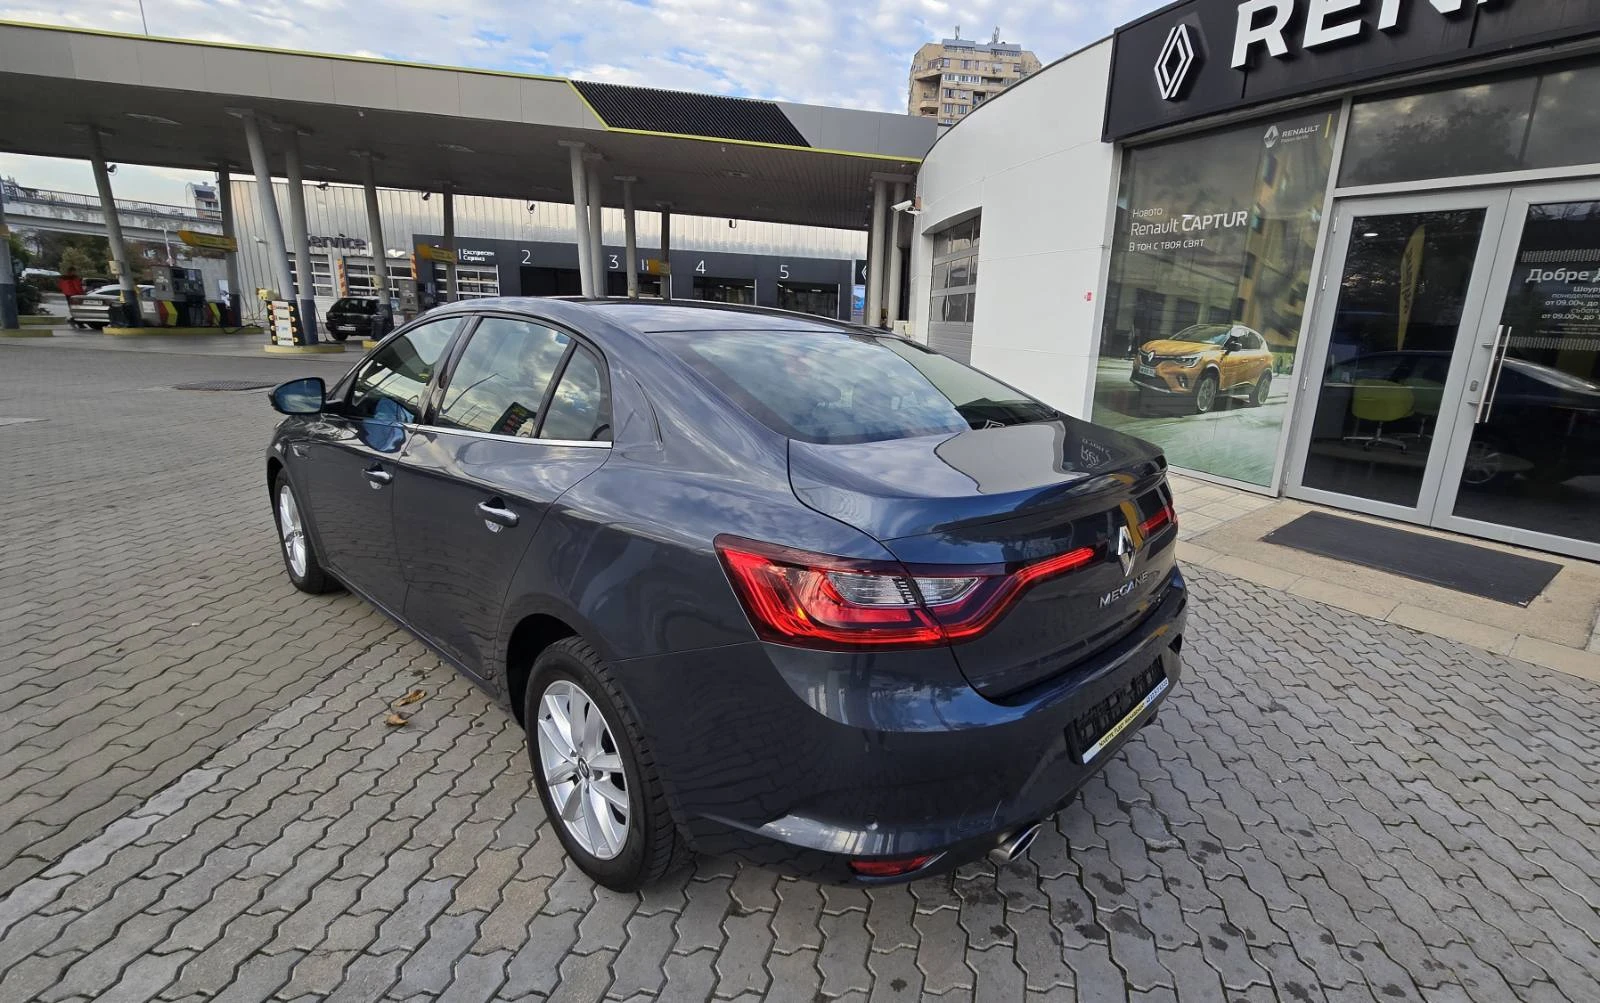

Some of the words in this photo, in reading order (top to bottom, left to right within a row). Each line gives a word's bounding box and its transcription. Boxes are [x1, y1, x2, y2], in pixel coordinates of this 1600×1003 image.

[1282, 124, 1320, 137] RENAULT
[1132, 207, 1163, 218] Новото
[1130, 218, 1180, 236] Renault
[1181, 210, 1248, 232] CAPTUR
[307, 233, 367, 250] ervice
[1137, 242, 1152, 251] тон
[1161, 240, 1181, 250] твоя
[1183, 239, 1205, 249] свят
[521, 249, 531, 265] 2
[608, 254, 619, 269] 3
[695, 259, 706, 275] 4
[779, 264, 790, 279] 5
[1525, 267, 1589, 284] Добре
[1099, 571, 1149, 608] MEGANE
